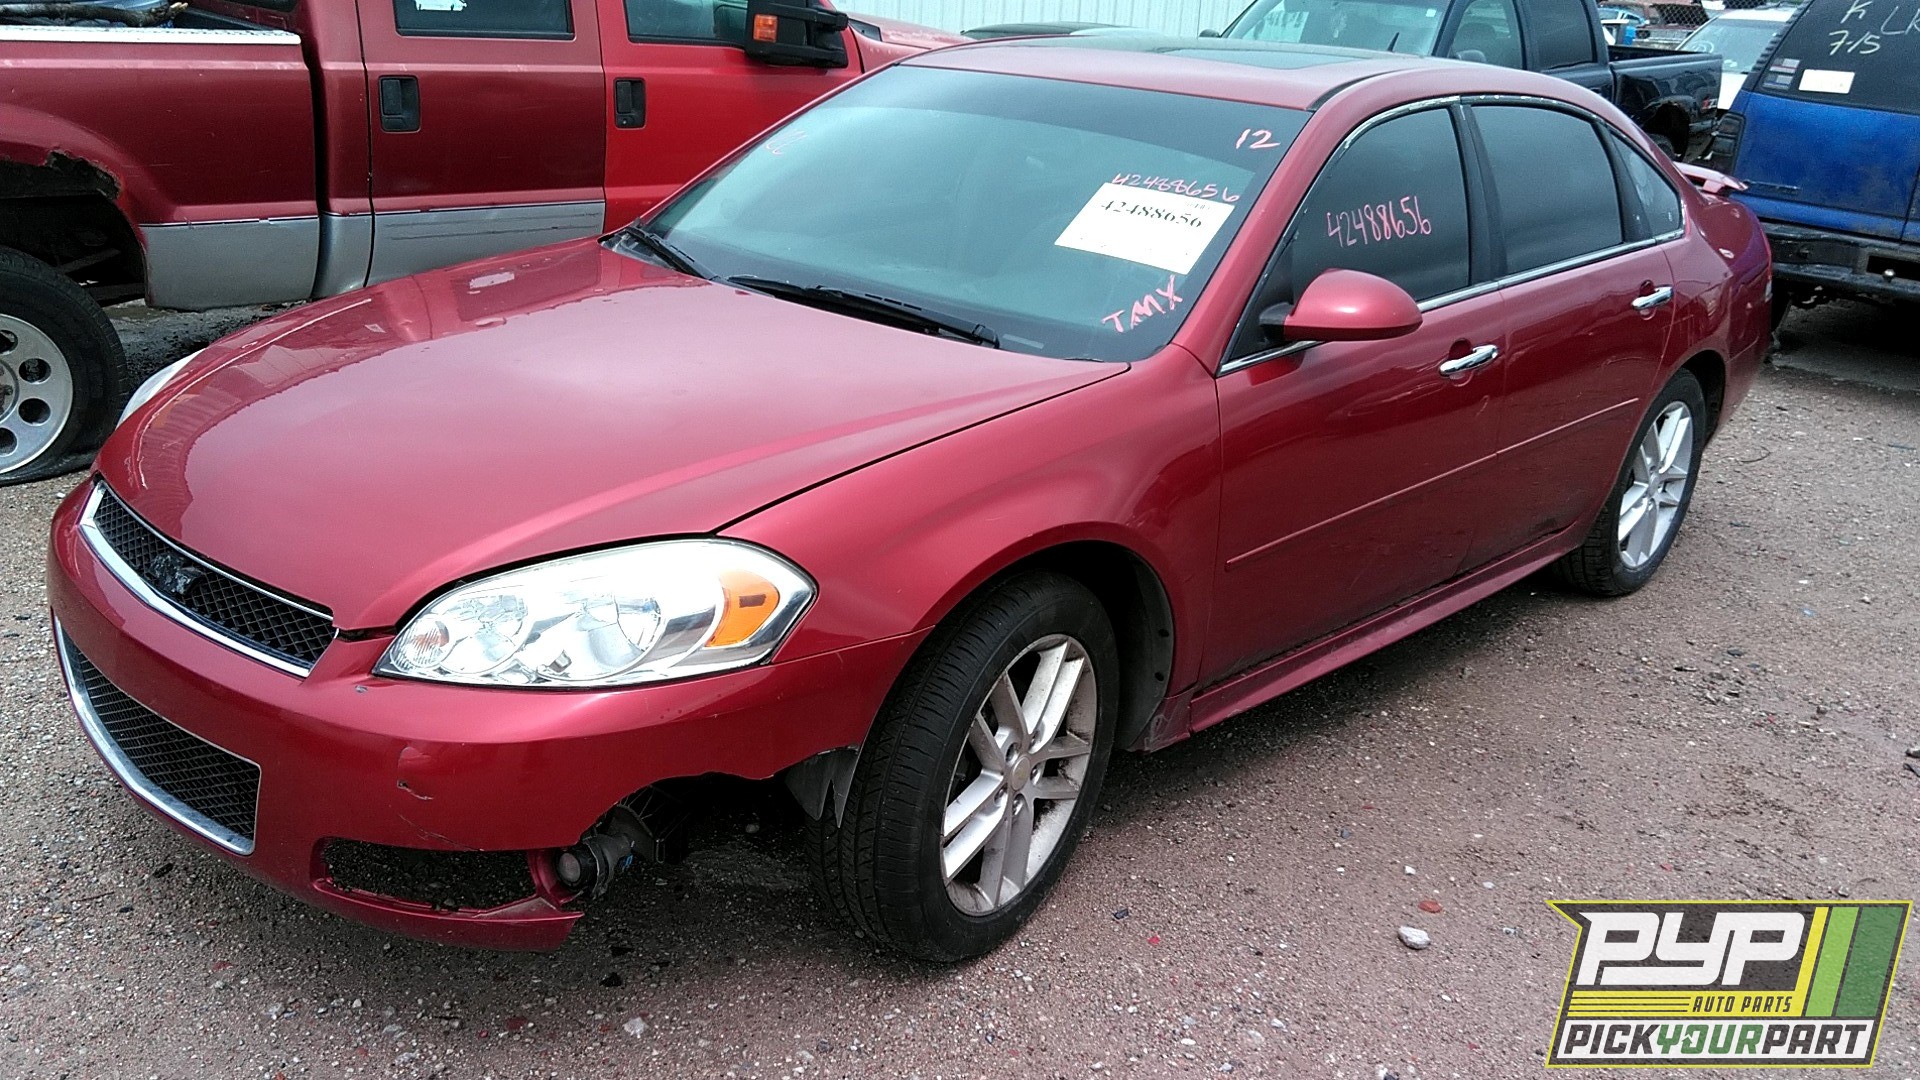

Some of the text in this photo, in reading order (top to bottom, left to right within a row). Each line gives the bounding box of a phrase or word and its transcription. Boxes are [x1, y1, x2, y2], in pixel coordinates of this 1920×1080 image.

[1829, 30, 1881, 55] 7-15
[1235, 128, 1281, 149] 12
[1112, 173, 1240, 202] 42488656
[1326, 195, 1432, 248] 42488656
[1100, 274, 1184, 333] TMX
